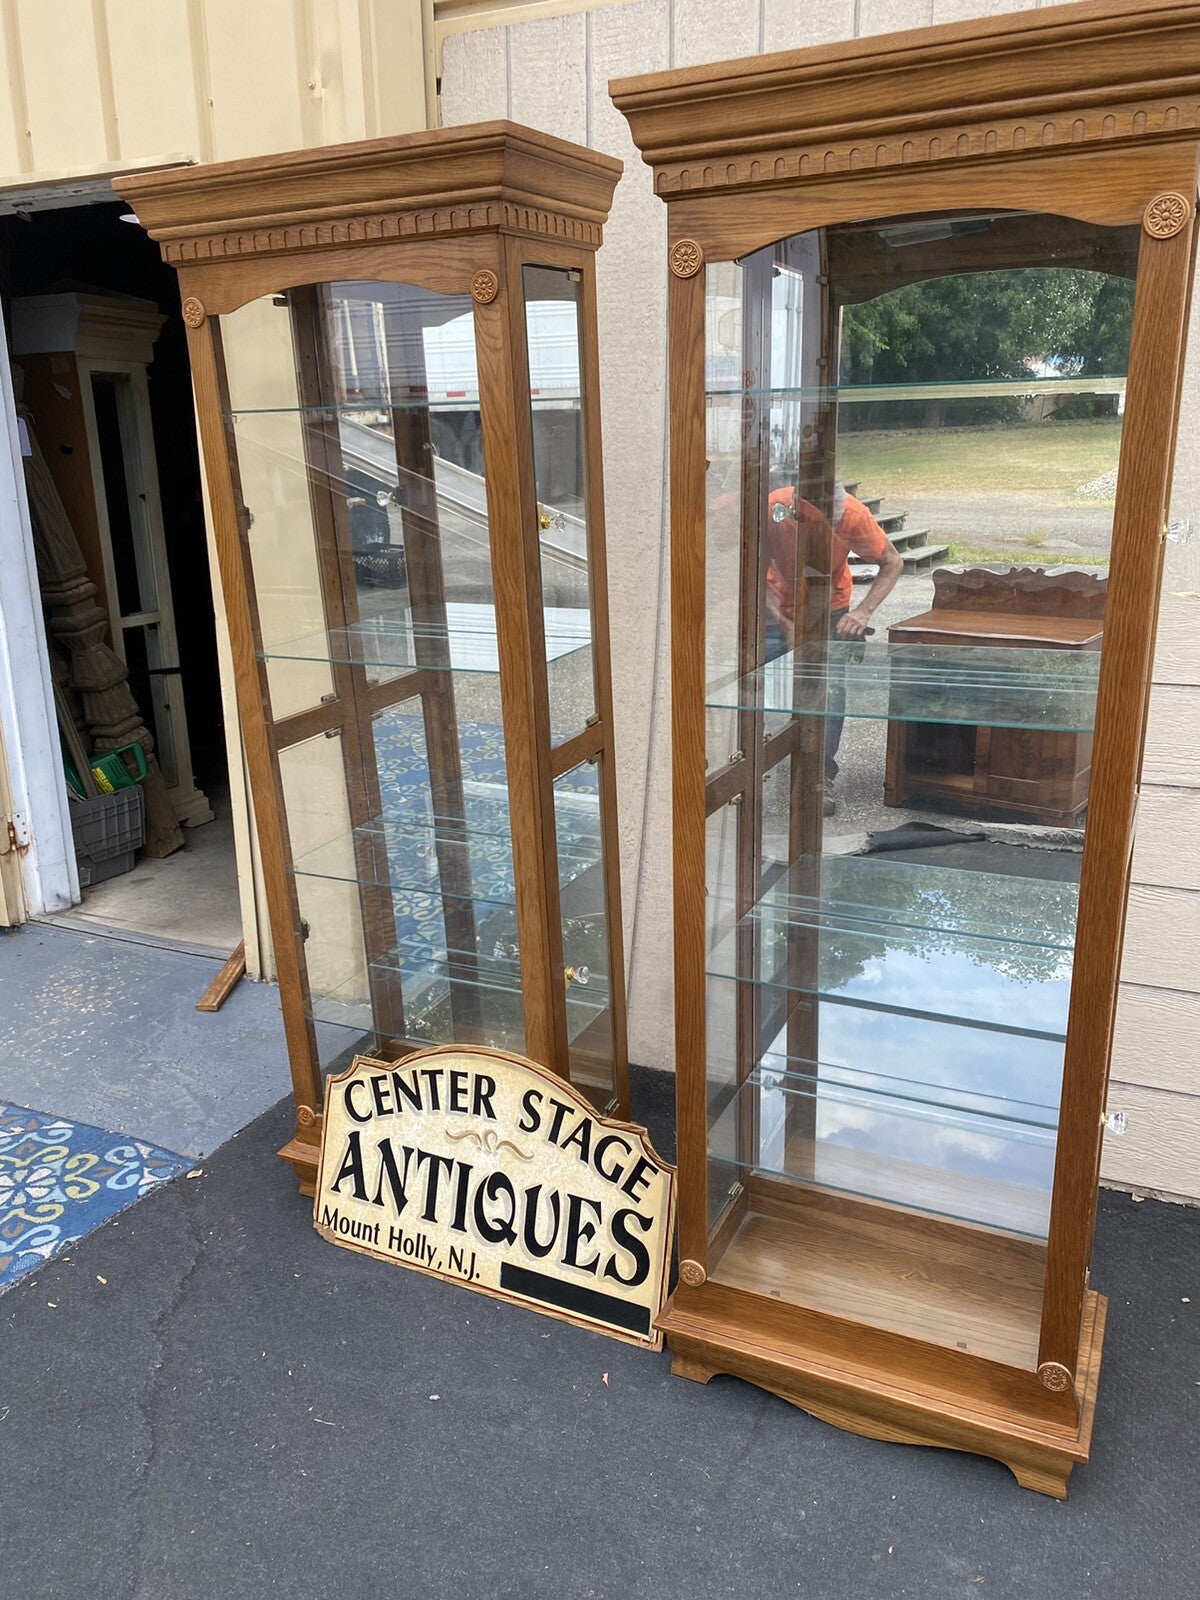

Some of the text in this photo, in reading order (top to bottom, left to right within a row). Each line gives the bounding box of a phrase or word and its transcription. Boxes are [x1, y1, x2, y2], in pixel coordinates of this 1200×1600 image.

[344, 1068, 659, 1204] CENTER STAGE
[321, 1204, 480, 1281] Mount Holly, N.J.
[331, 1131, 654, 1287] ANTIQUES
